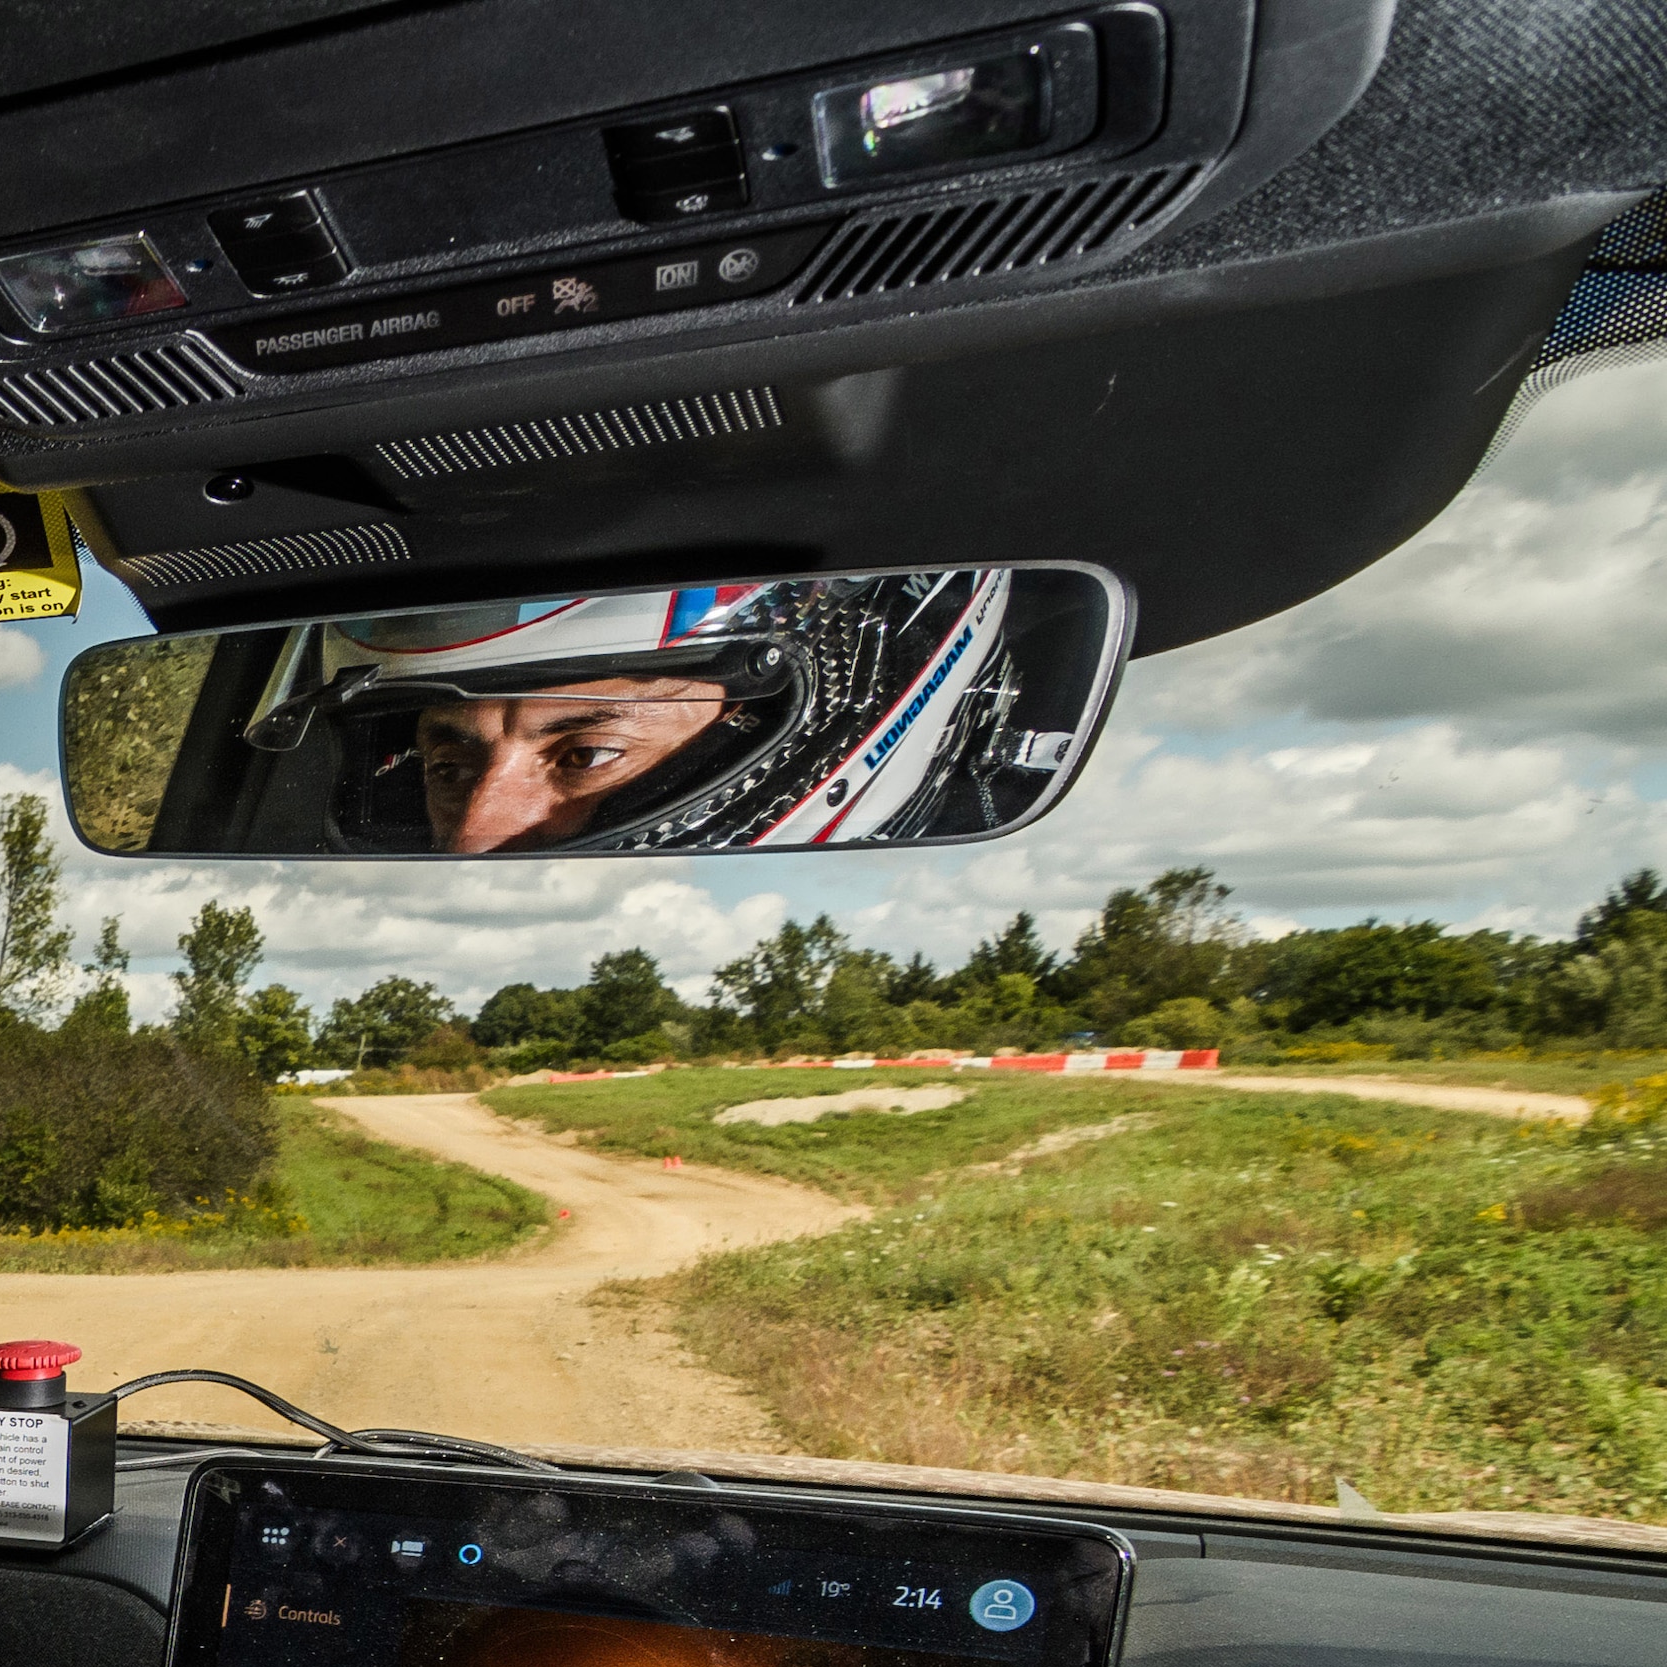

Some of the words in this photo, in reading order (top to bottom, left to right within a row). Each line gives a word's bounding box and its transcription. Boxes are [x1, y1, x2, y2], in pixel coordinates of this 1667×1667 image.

[660, 263, 694, 287] ON
[496, 293, 535, 317] OFF
[255, 323, 363, 356] PASSENGER
[369, 311, 439, 338] AIRBAG
[9, 587, 52, 601] start
[19, 603, 36, 614] is
[40, 602, 69, 613] on
[892, 1585, 943, 1610] 2:14
[278, 1605, 341, 1626] Controls
